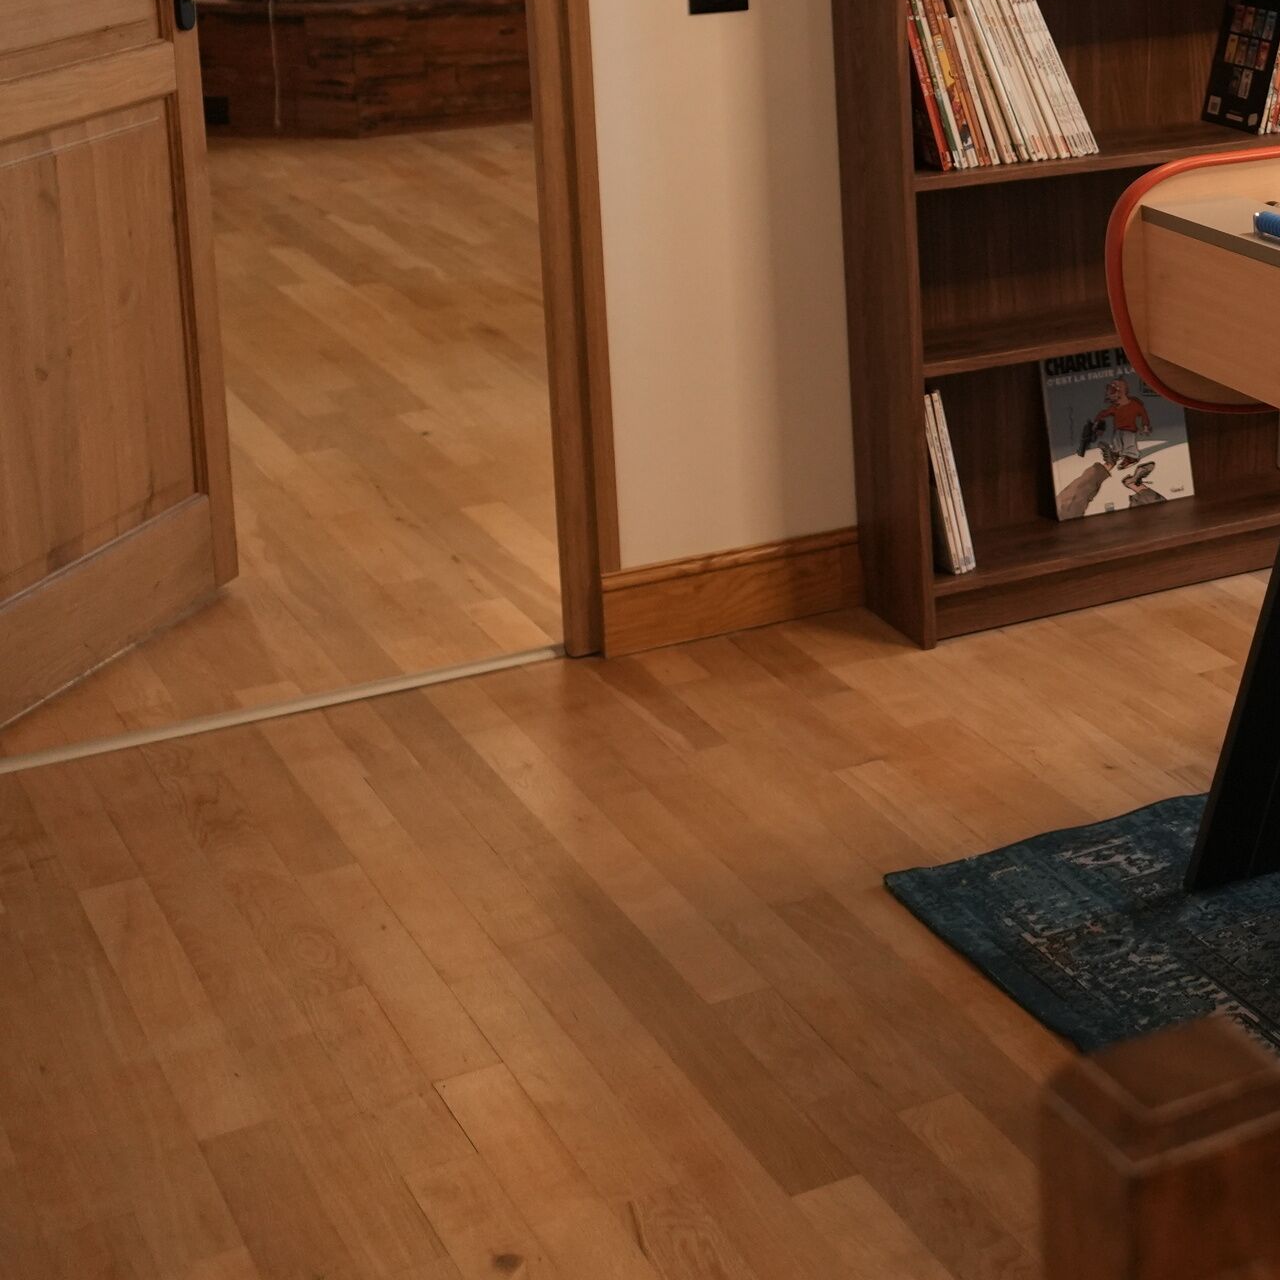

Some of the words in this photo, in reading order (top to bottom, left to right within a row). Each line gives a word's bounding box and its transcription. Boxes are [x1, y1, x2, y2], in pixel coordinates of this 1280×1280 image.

[1045, 350, 1112, 375] CHARLIE
[1046, 377, 1072, 386] C'EST
[1088, 369, 1114, 380] FAUTE
